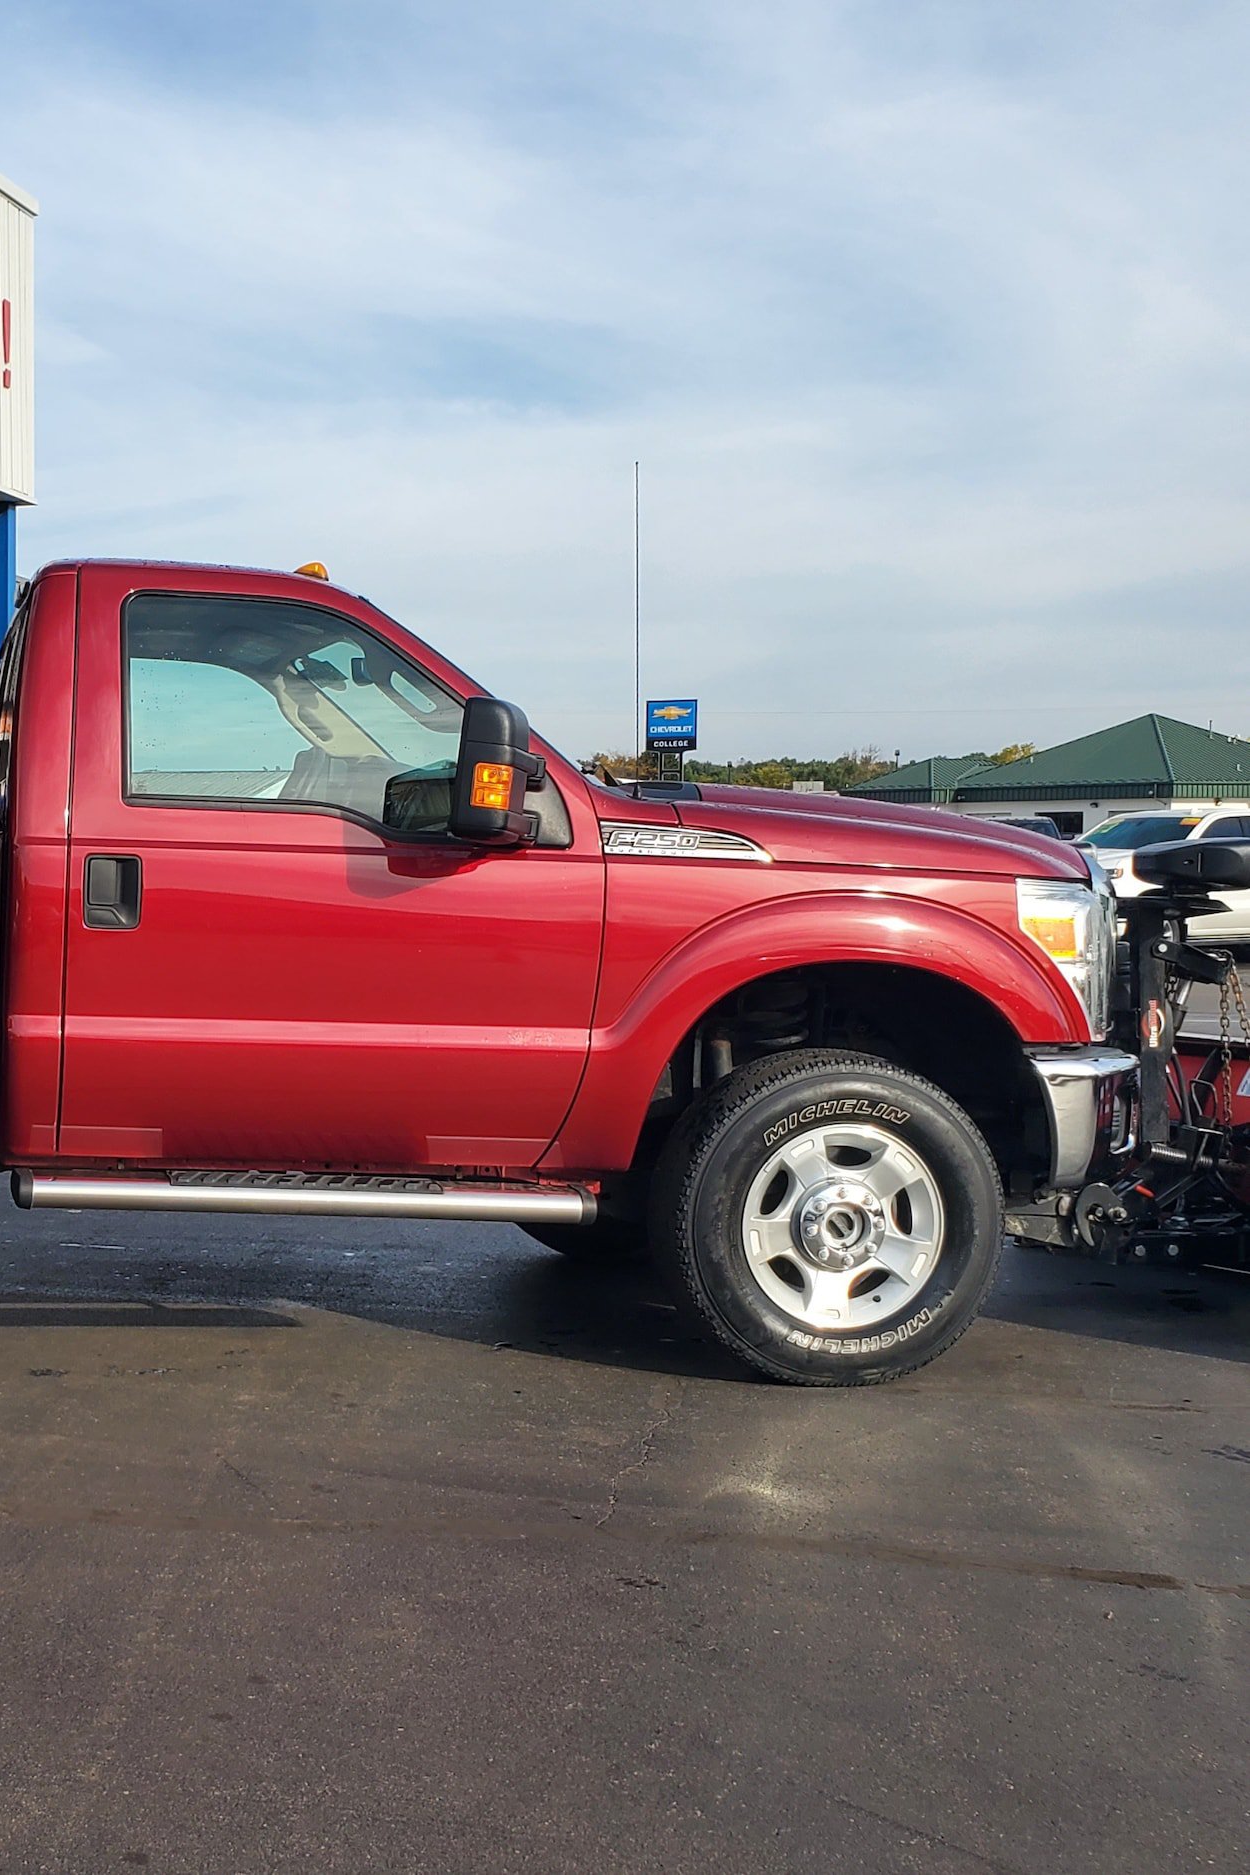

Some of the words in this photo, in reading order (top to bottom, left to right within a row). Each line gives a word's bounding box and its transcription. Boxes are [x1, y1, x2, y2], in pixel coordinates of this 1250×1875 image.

[650, 725, 693, 734] CHEVROLET
[653, 740, 689, 748] COLLEGE
[607, 830, 700, 850] F-250
[763, 1099, 910, 1147] MICHELIN
[787, 1307, 932, 1355] MICHELIN
